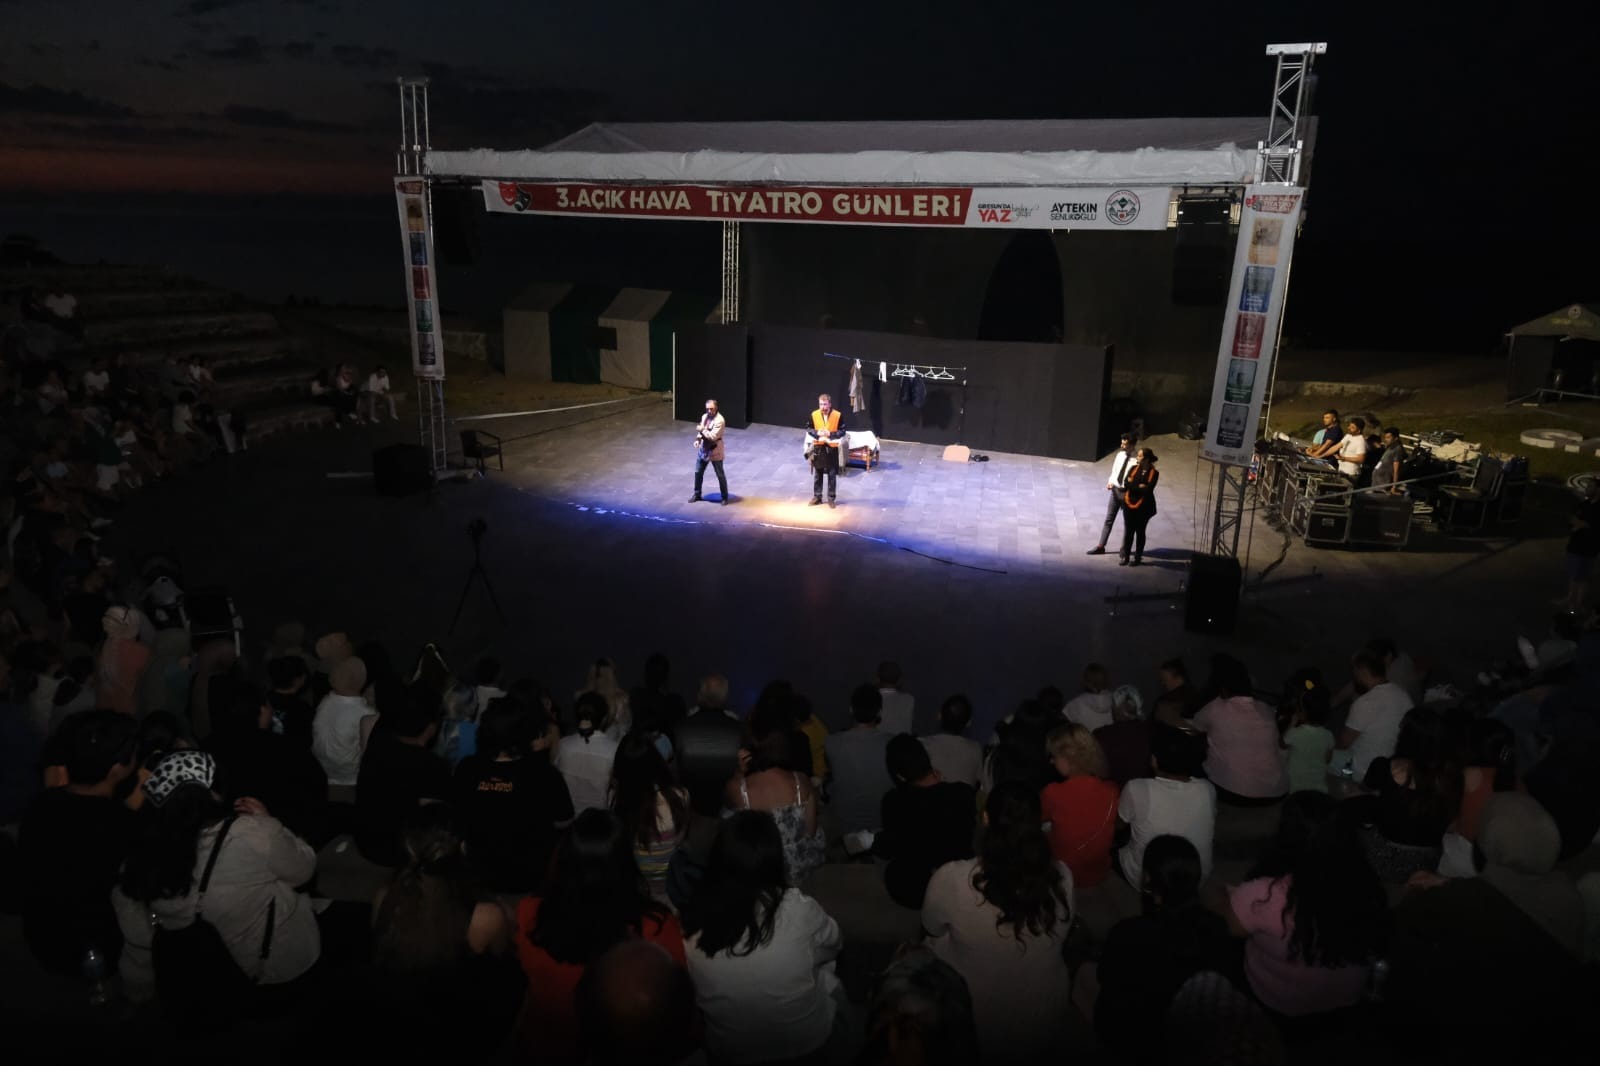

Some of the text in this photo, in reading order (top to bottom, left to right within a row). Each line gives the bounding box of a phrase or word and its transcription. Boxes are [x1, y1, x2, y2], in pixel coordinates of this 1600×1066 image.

[555, 187, 961, 217] 3.AÇIK HAVA TİYATRO GÜNLERİ
[978, 209, 1011, 222] YAZ
